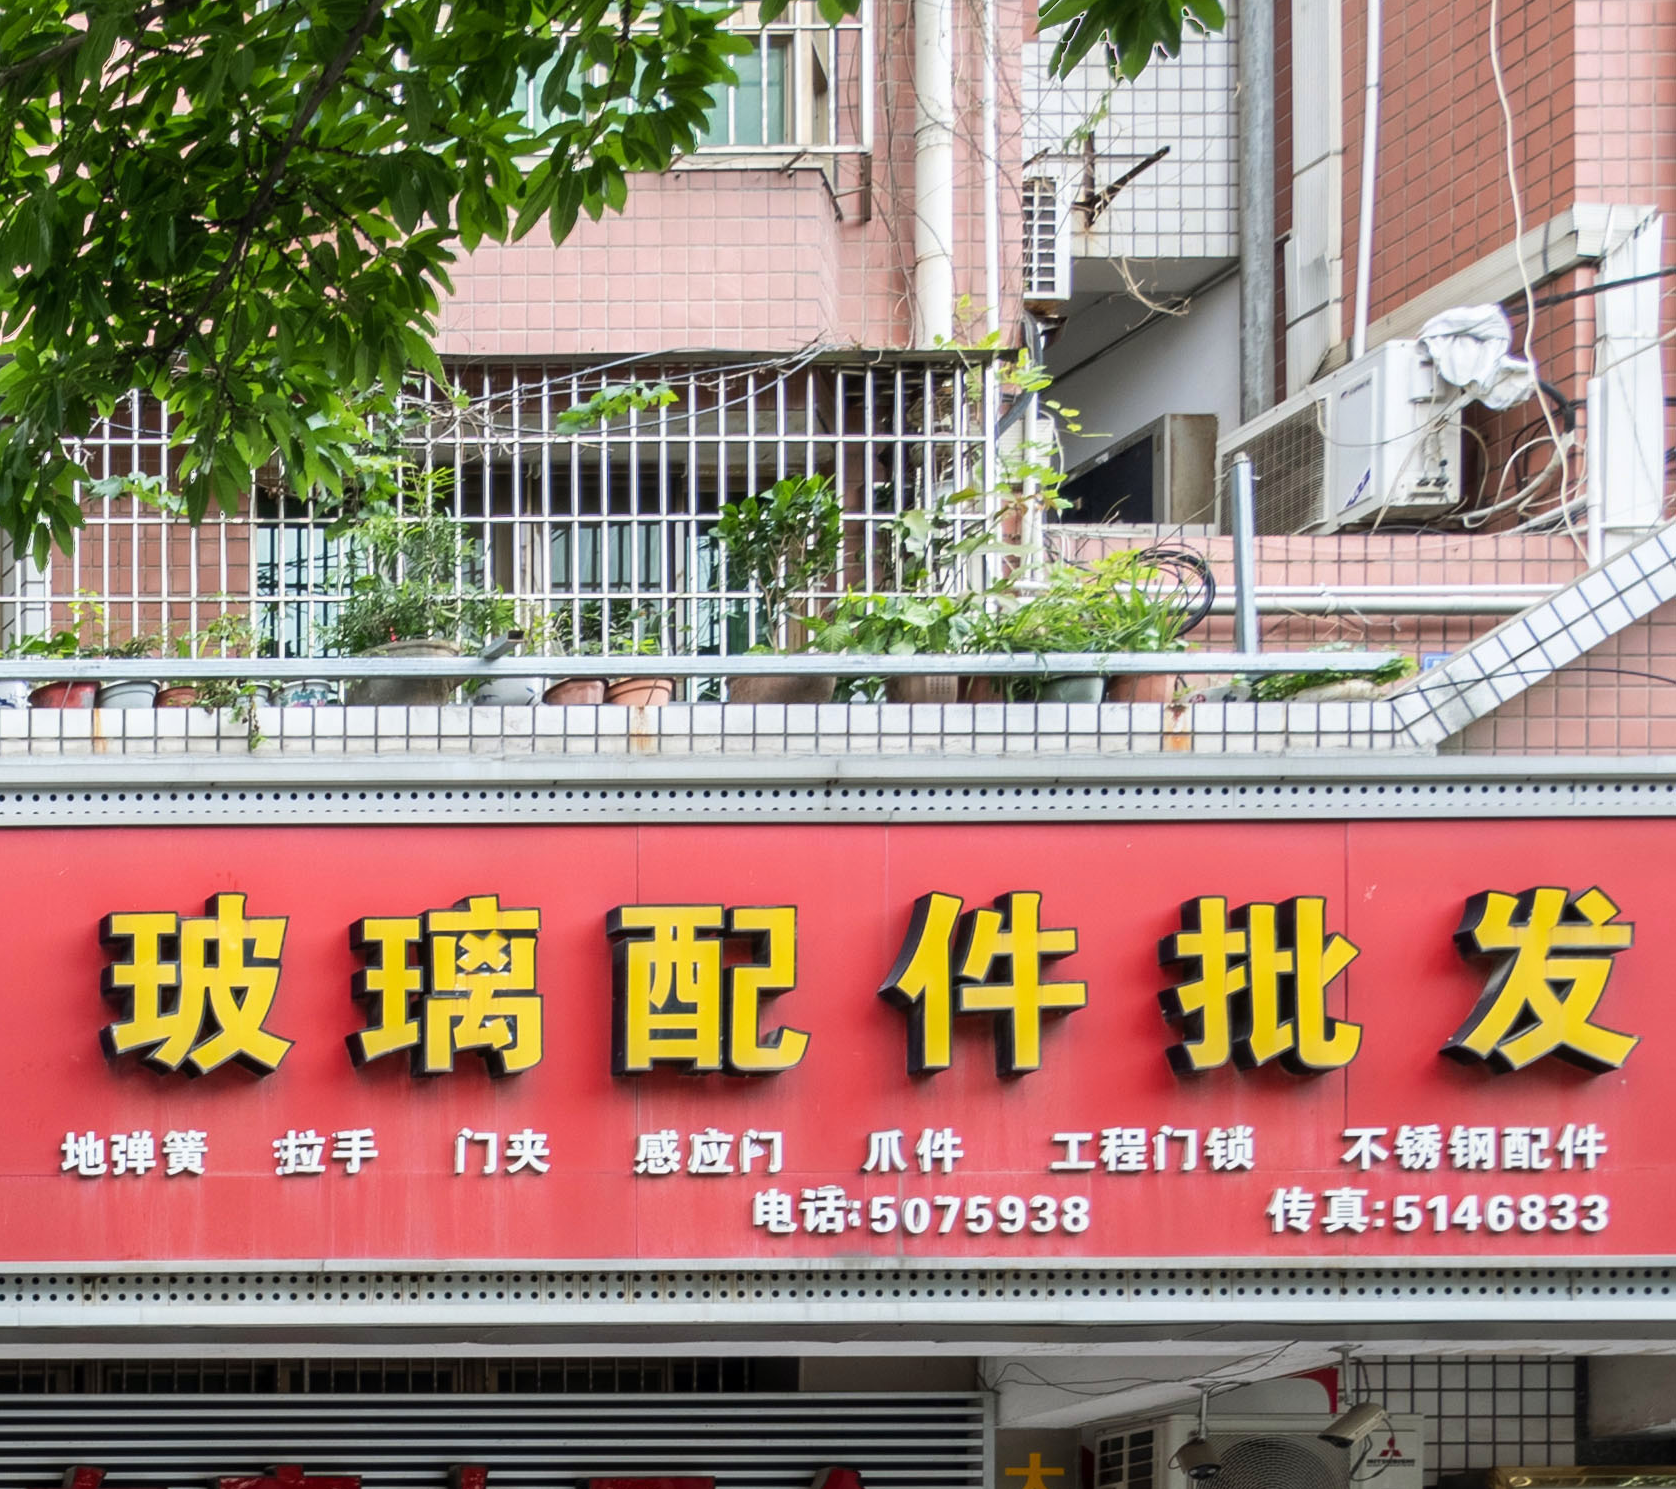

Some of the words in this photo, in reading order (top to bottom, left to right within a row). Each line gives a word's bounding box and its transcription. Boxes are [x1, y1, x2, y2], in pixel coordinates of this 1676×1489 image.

[100, 886, 1640, 1080] 玻璃配件批发
[61, 1130, 210, 1178] 地弹簧
[275, 1128, 379, 1178] 拉手
[454, 1127, 551, 1176] 门夹
[634, 1128, 784, 1176] 感应门
[863, 1127, 965, 1175] 爪件
[1050, 1125, 1255, 1174] 工程门锁
[1342, 1122, 1608, 1174] 不锈钢配件
[752, 1186, 1092, 1237] 电话:5075938
[1266, 1186, 1611, 1236] 传真:5146833
